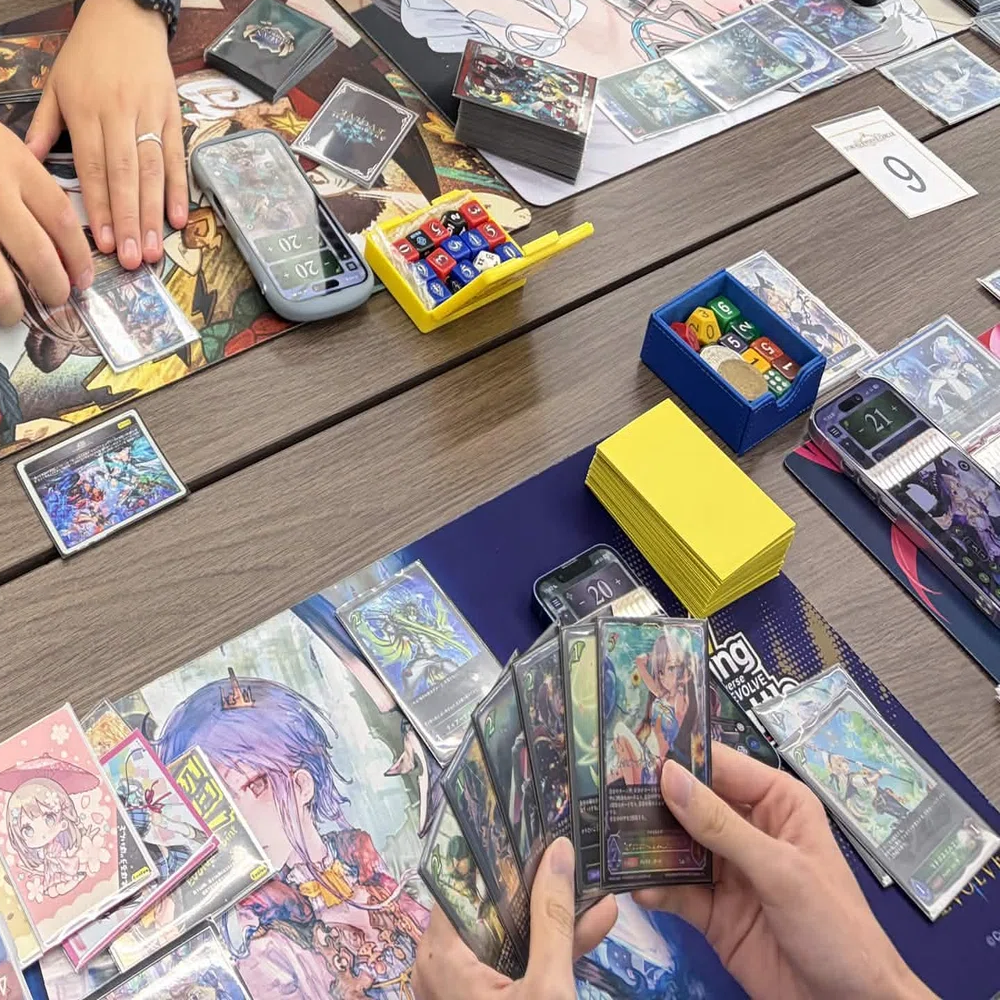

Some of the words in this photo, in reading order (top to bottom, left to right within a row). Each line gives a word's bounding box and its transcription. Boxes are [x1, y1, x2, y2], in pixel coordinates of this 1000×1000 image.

[882, 155, 927, 193] 9
[279, 235, 302, 253] 20
[295, 259, 319, 280] 20
[865, 408, 893, 432] 21
[587, 580, 614, 606] 20
[709, 639, 754, 683] ing
[725, 674, 746, 692] erse
